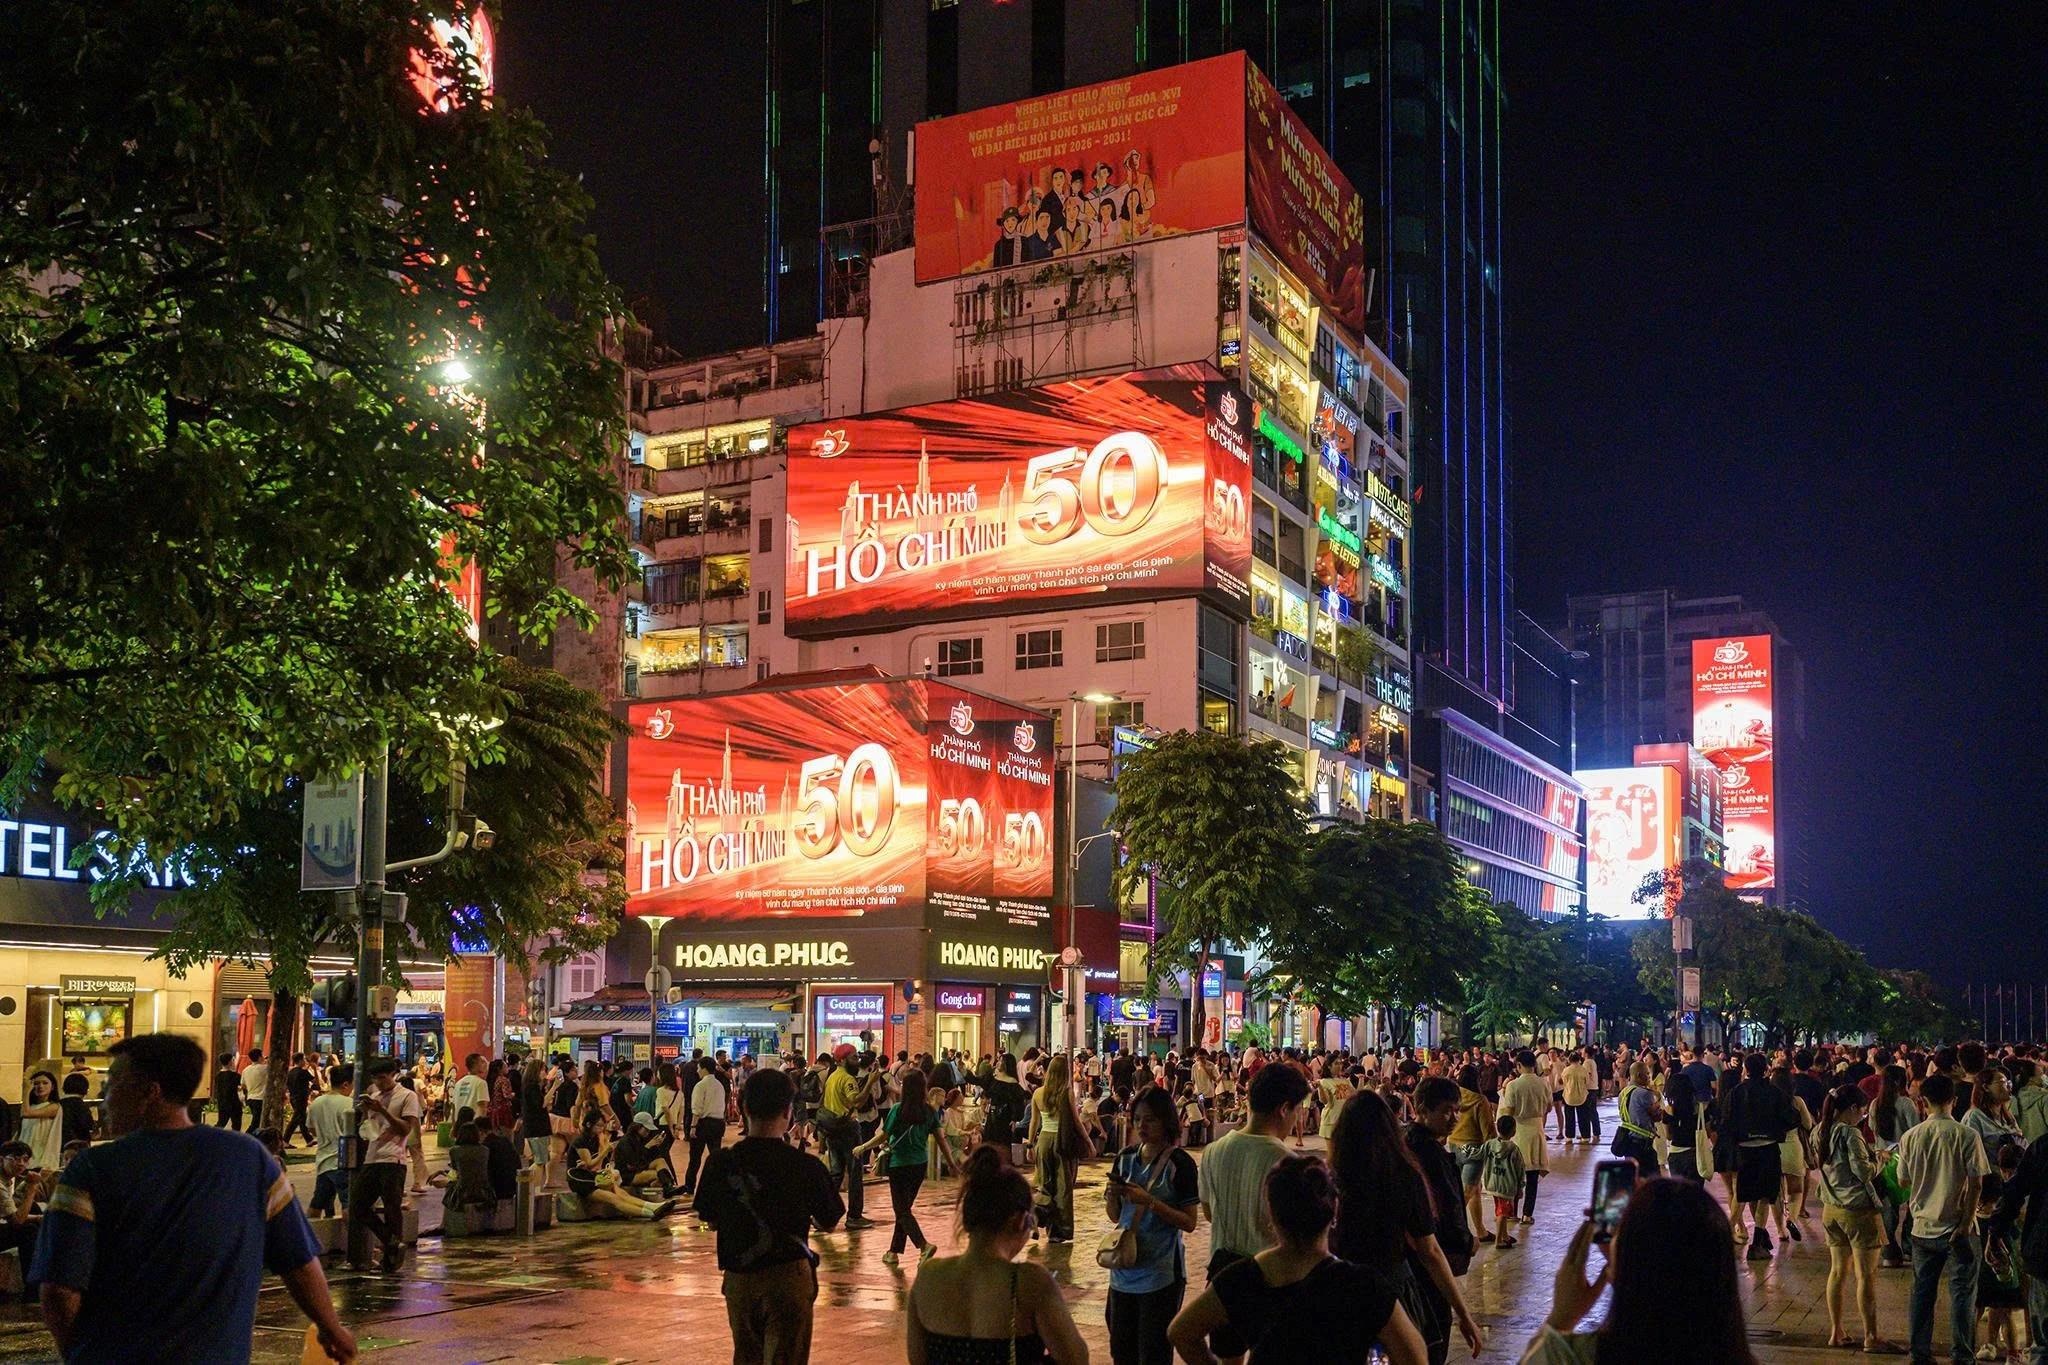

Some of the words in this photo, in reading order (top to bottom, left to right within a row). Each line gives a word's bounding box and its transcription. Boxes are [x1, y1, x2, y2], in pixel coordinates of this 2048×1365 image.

[1069, 137, 1093, 153] 2026
[1207, 422, 1219, 441] HỒ
[1219, 433, 1233, 453] CHÍ
[1232, 442, 1250, 467] MINH
[852, 484, 944, 522] THÀNH
[946, 483, 978, 514] PHỐ
[1018, 431, 1169, 546] 50
[1212, 478, 1246, 545] 50
[806, 521, 886, 597] HỒ
[897, 519, 961, 572] CHÍ
[963, 520, 1009, 556] MINH
[1329, 538, 1340, 556] THE
[1339, 546, 1360, 570] LETTER
[1696, 670, 1714, 681] HỒ
[1715, 670, 1736, 680] CHÍ
[1737, 668, 1767, 679] MINH
[1375, 676, 1393, 705] THE
[1394, 687, 1411, 713] ONE
[930, 741, 947, 760] HỒ
[947, 749, 965, 765] CHÍ
[966, 754, 991, 771] MINH
[943, 733, 967, 749] THÀNH
[966, 740, 981, 753] PHỐ
[997, 758, 1012, 776] HỒ
[1012, 765, 1028, 781] CHÍ
[1028, 772, 1050, 787] MINH
[1007, 752, 1029, 766] THÀNH
[1029, 757, 1042, 769] PHỐ
[676, 776, 741, 816] THÀNH
[742, 783, 767, 814] PHỐ
[796, 742, 900, 860] 50
[1738, 794, 1770, 804] MINH
[937, 797, 985, 862] 50
[1003, 810, 1046, 871] 50
[641, 818, 700, 894] HỒ
[707, 820, 751, 872] CHÍ
[753, 830, 788, 864] MINH
[676, 942, 768, 967] HOANG
[773, 941, 852, 967] PHUC
[940, 941, 1000, 967] HOANG
[1001, 945, 1044, 970] PHUC
[65, 980, 98, 992] BIER
[941, 991, 963, 1009] Gong
[963, 992, 977, 1006] cha
[829, 998, 857, 1013] Gong
[858, 998, 876, 1010] cha
[697, 1024, 708, 1033] 97
